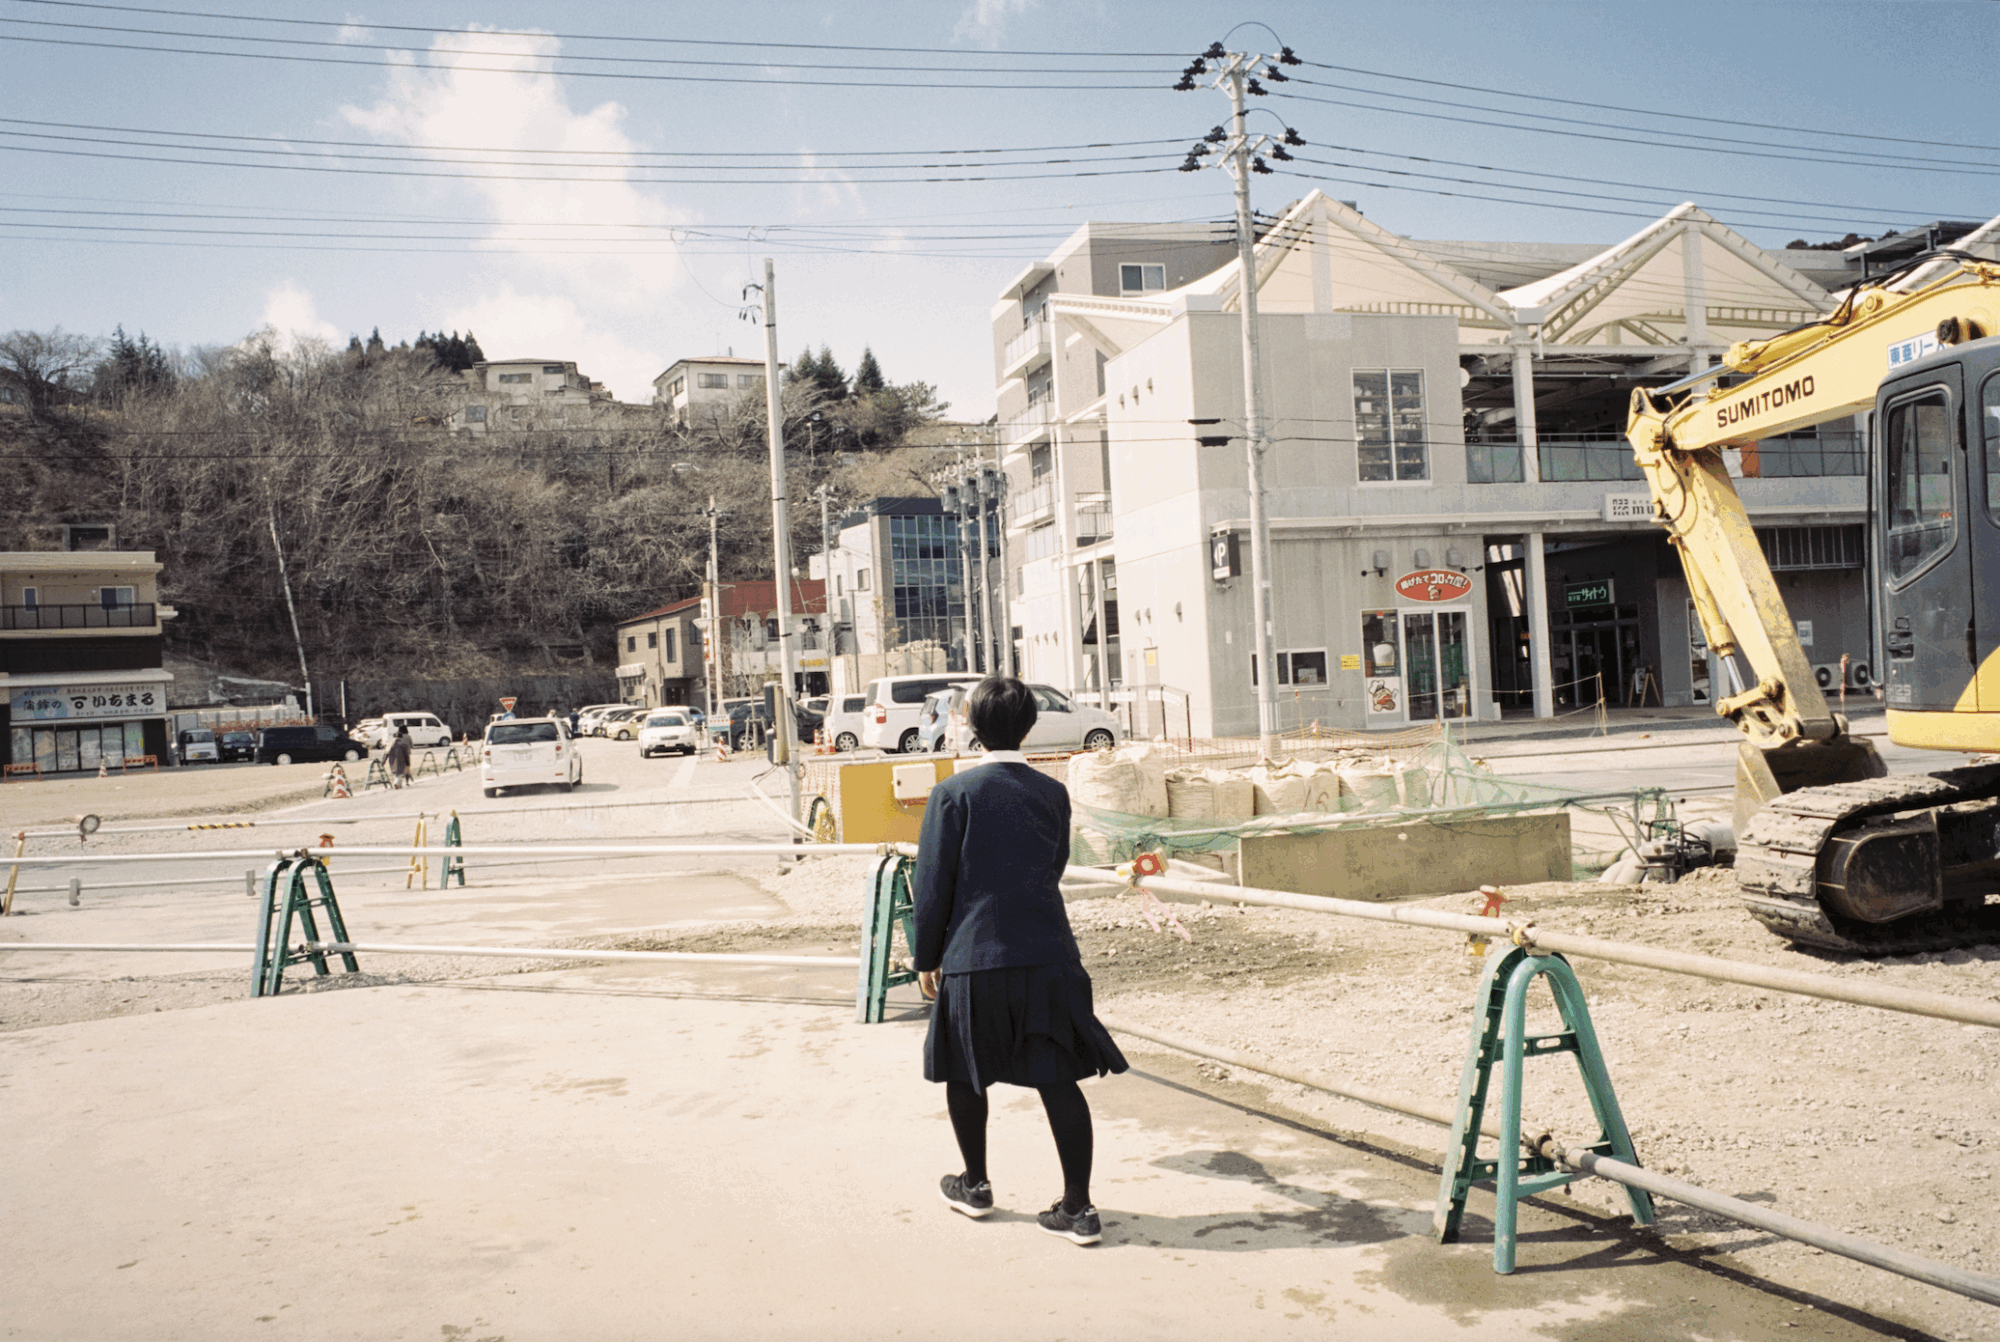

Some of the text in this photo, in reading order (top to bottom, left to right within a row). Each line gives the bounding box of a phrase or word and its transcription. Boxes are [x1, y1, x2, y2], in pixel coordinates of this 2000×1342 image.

[1717, 375, 1815, 428] SUMITOMO
[1217, 542, 1227, 567] P
[92, 692, 155, 708] いちまる
